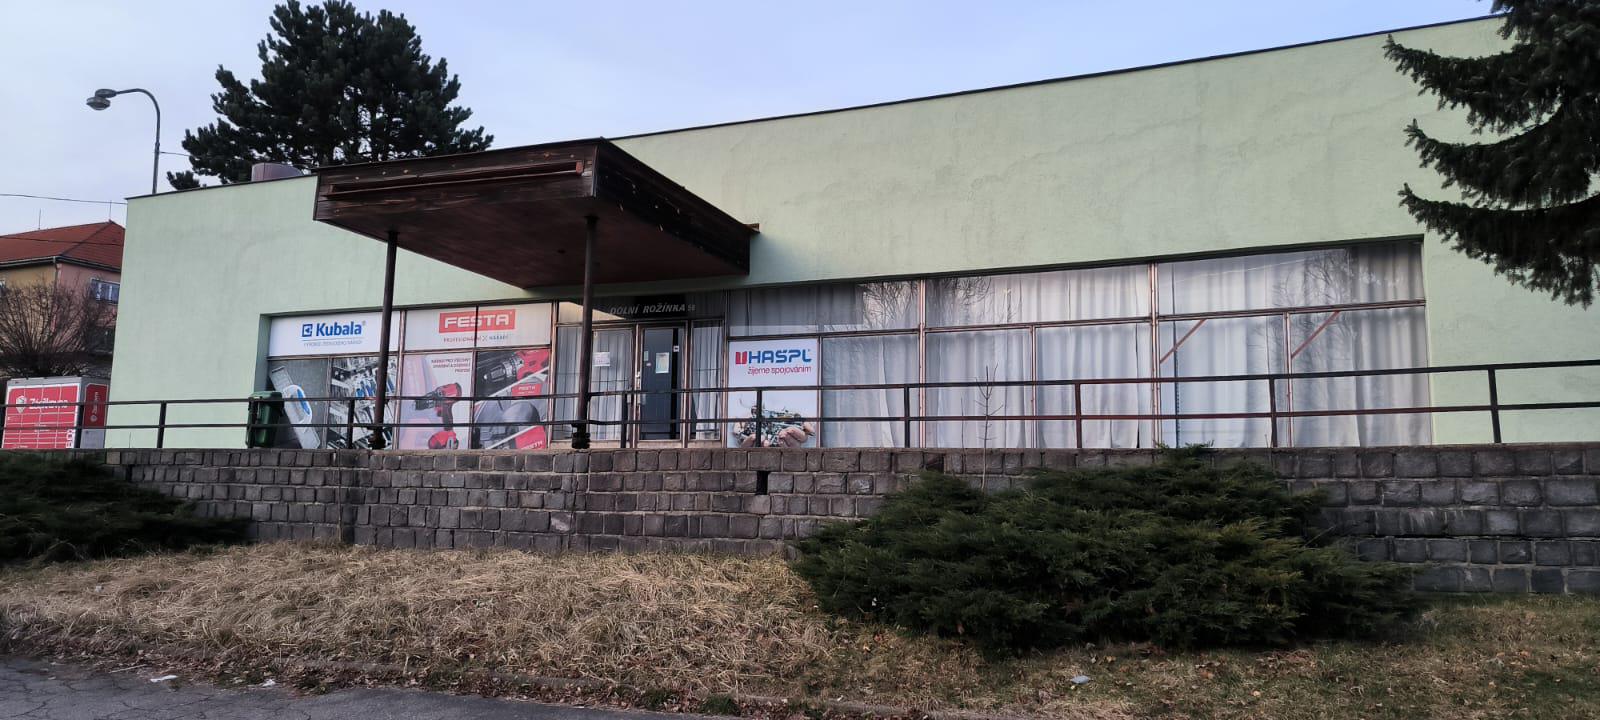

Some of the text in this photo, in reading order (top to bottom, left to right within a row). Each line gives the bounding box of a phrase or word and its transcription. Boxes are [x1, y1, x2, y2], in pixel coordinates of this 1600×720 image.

[609, 304, 639, 315] DOLNÍ
[643, 302, 686, 314] ROŽÍNKA
[316, 321, 362, 337] Kubala
[444, 314, 510, 329] FESTA
[748, 349, 812, 364] HAŠPL
[748, 365, 812, 376] žijeme spojováním
